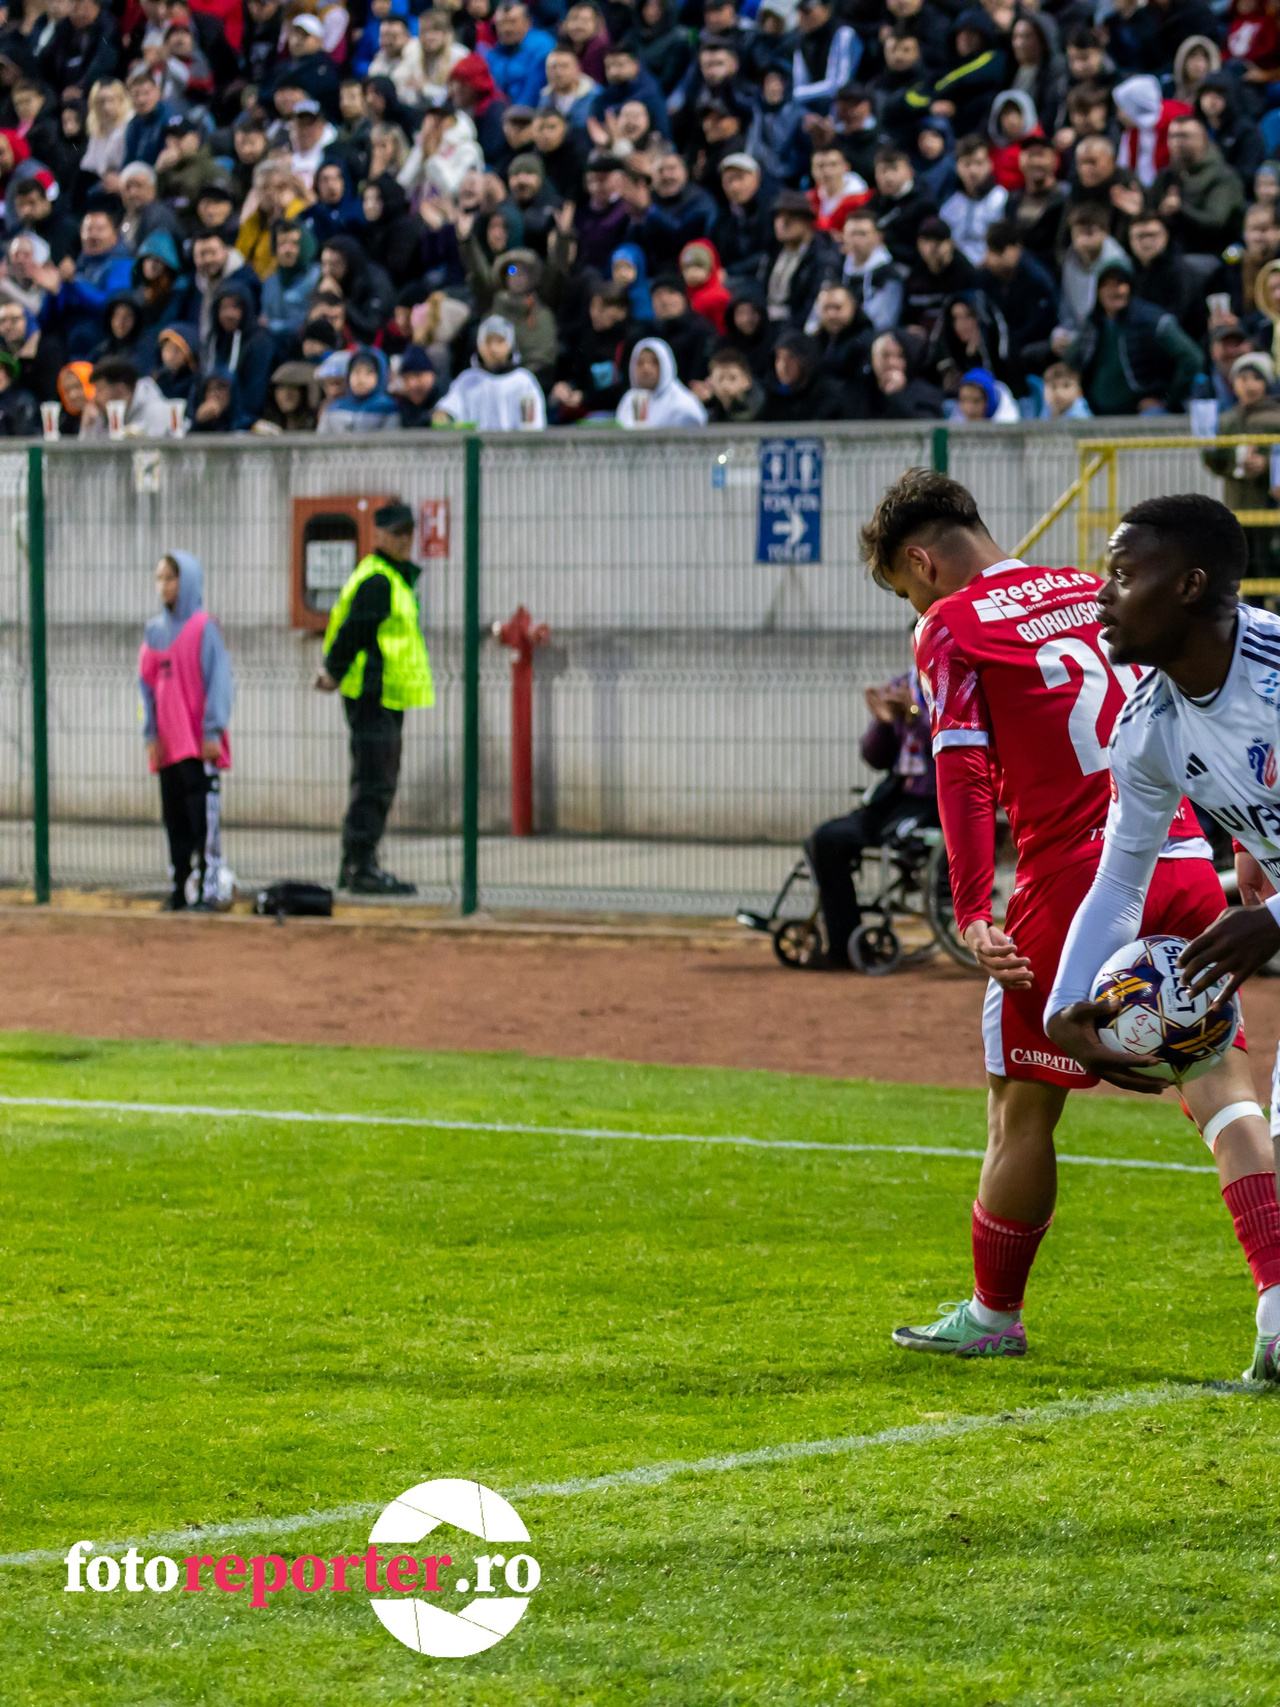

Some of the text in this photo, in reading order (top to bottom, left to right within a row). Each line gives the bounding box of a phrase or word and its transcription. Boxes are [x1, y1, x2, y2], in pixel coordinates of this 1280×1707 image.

[986, 573, 1097, 607] Regata.ro
[1016, 600, 1102, 643] BORDUSA
[1010, 1047, 1087, 1076] CARPATIN
